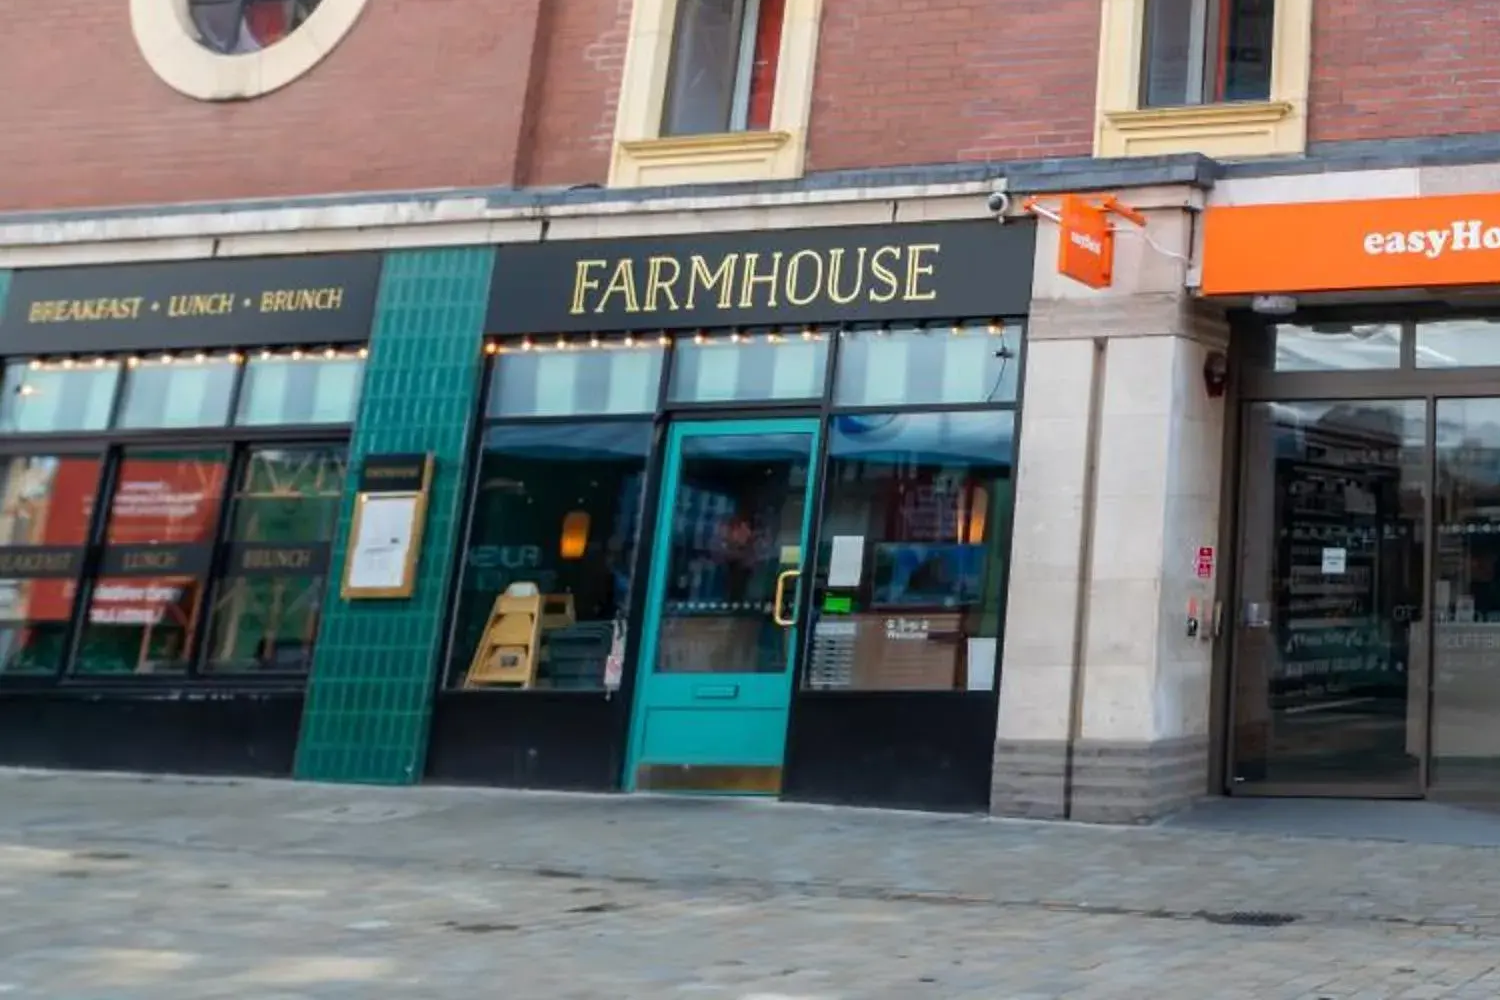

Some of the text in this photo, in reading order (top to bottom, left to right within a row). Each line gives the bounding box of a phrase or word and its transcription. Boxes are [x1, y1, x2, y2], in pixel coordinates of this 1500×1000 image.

[569, 243, 940, 314] FARMHOUSE
[28, 288, 344, 323] BREAKFAST LUNCH BRUNCH
